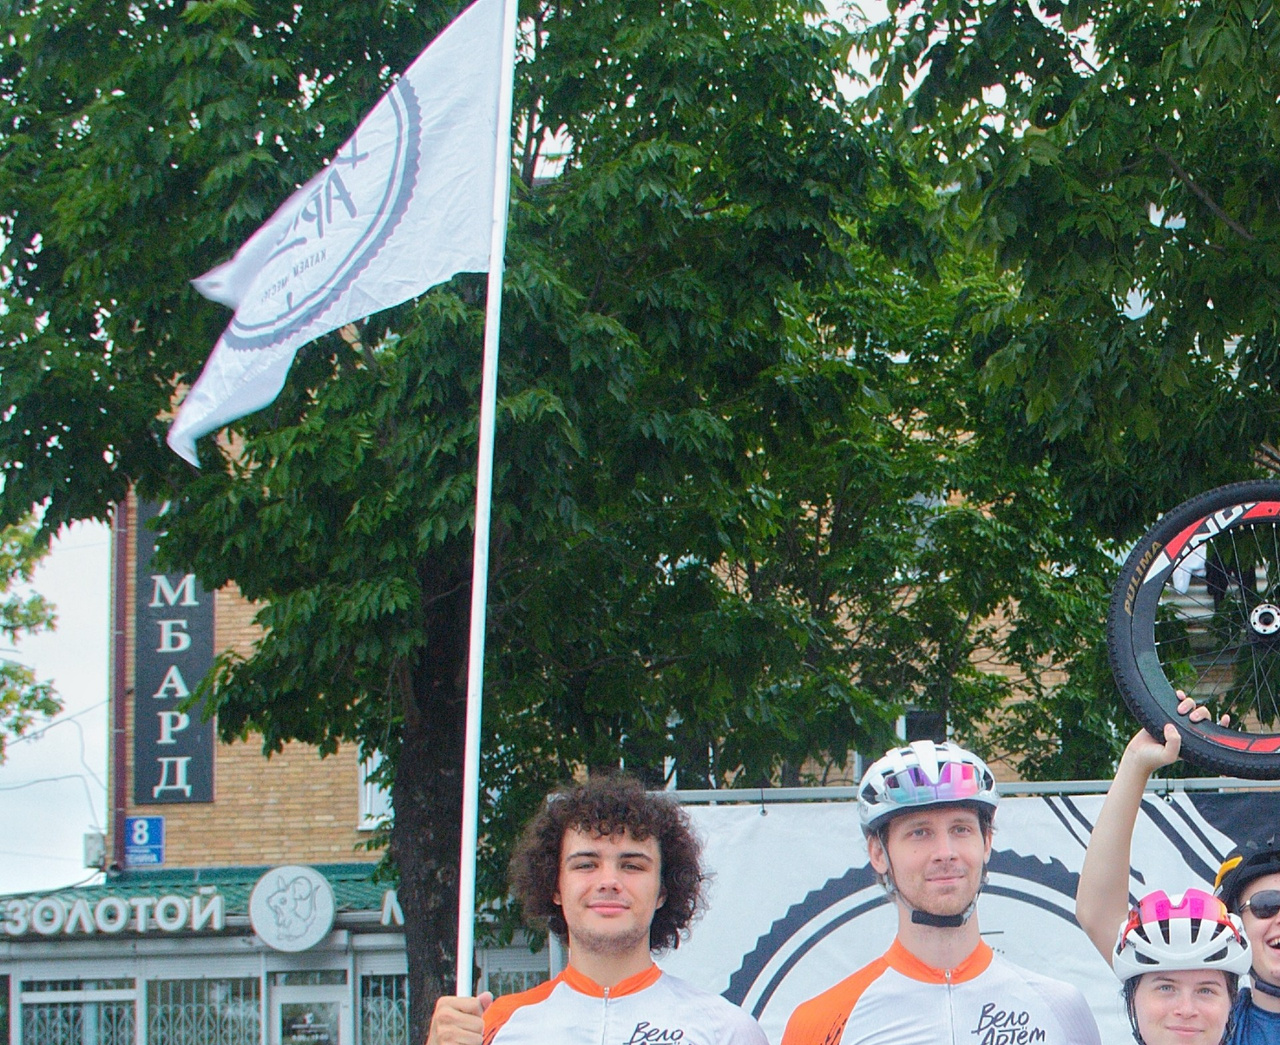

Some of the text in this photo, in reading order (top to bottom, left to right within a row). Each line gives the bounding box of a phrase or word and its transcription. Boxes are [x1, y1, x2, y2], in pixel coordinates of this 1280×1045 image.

[148, 505, 199, 798] МБАРД
[132, 819, 150, 845] 8
[4, 885, 226, 935] ЗОЛОТОЙ
[622, 1022, 684, 1045] Вело
[971, 1003, 1030, 1035] Вело
